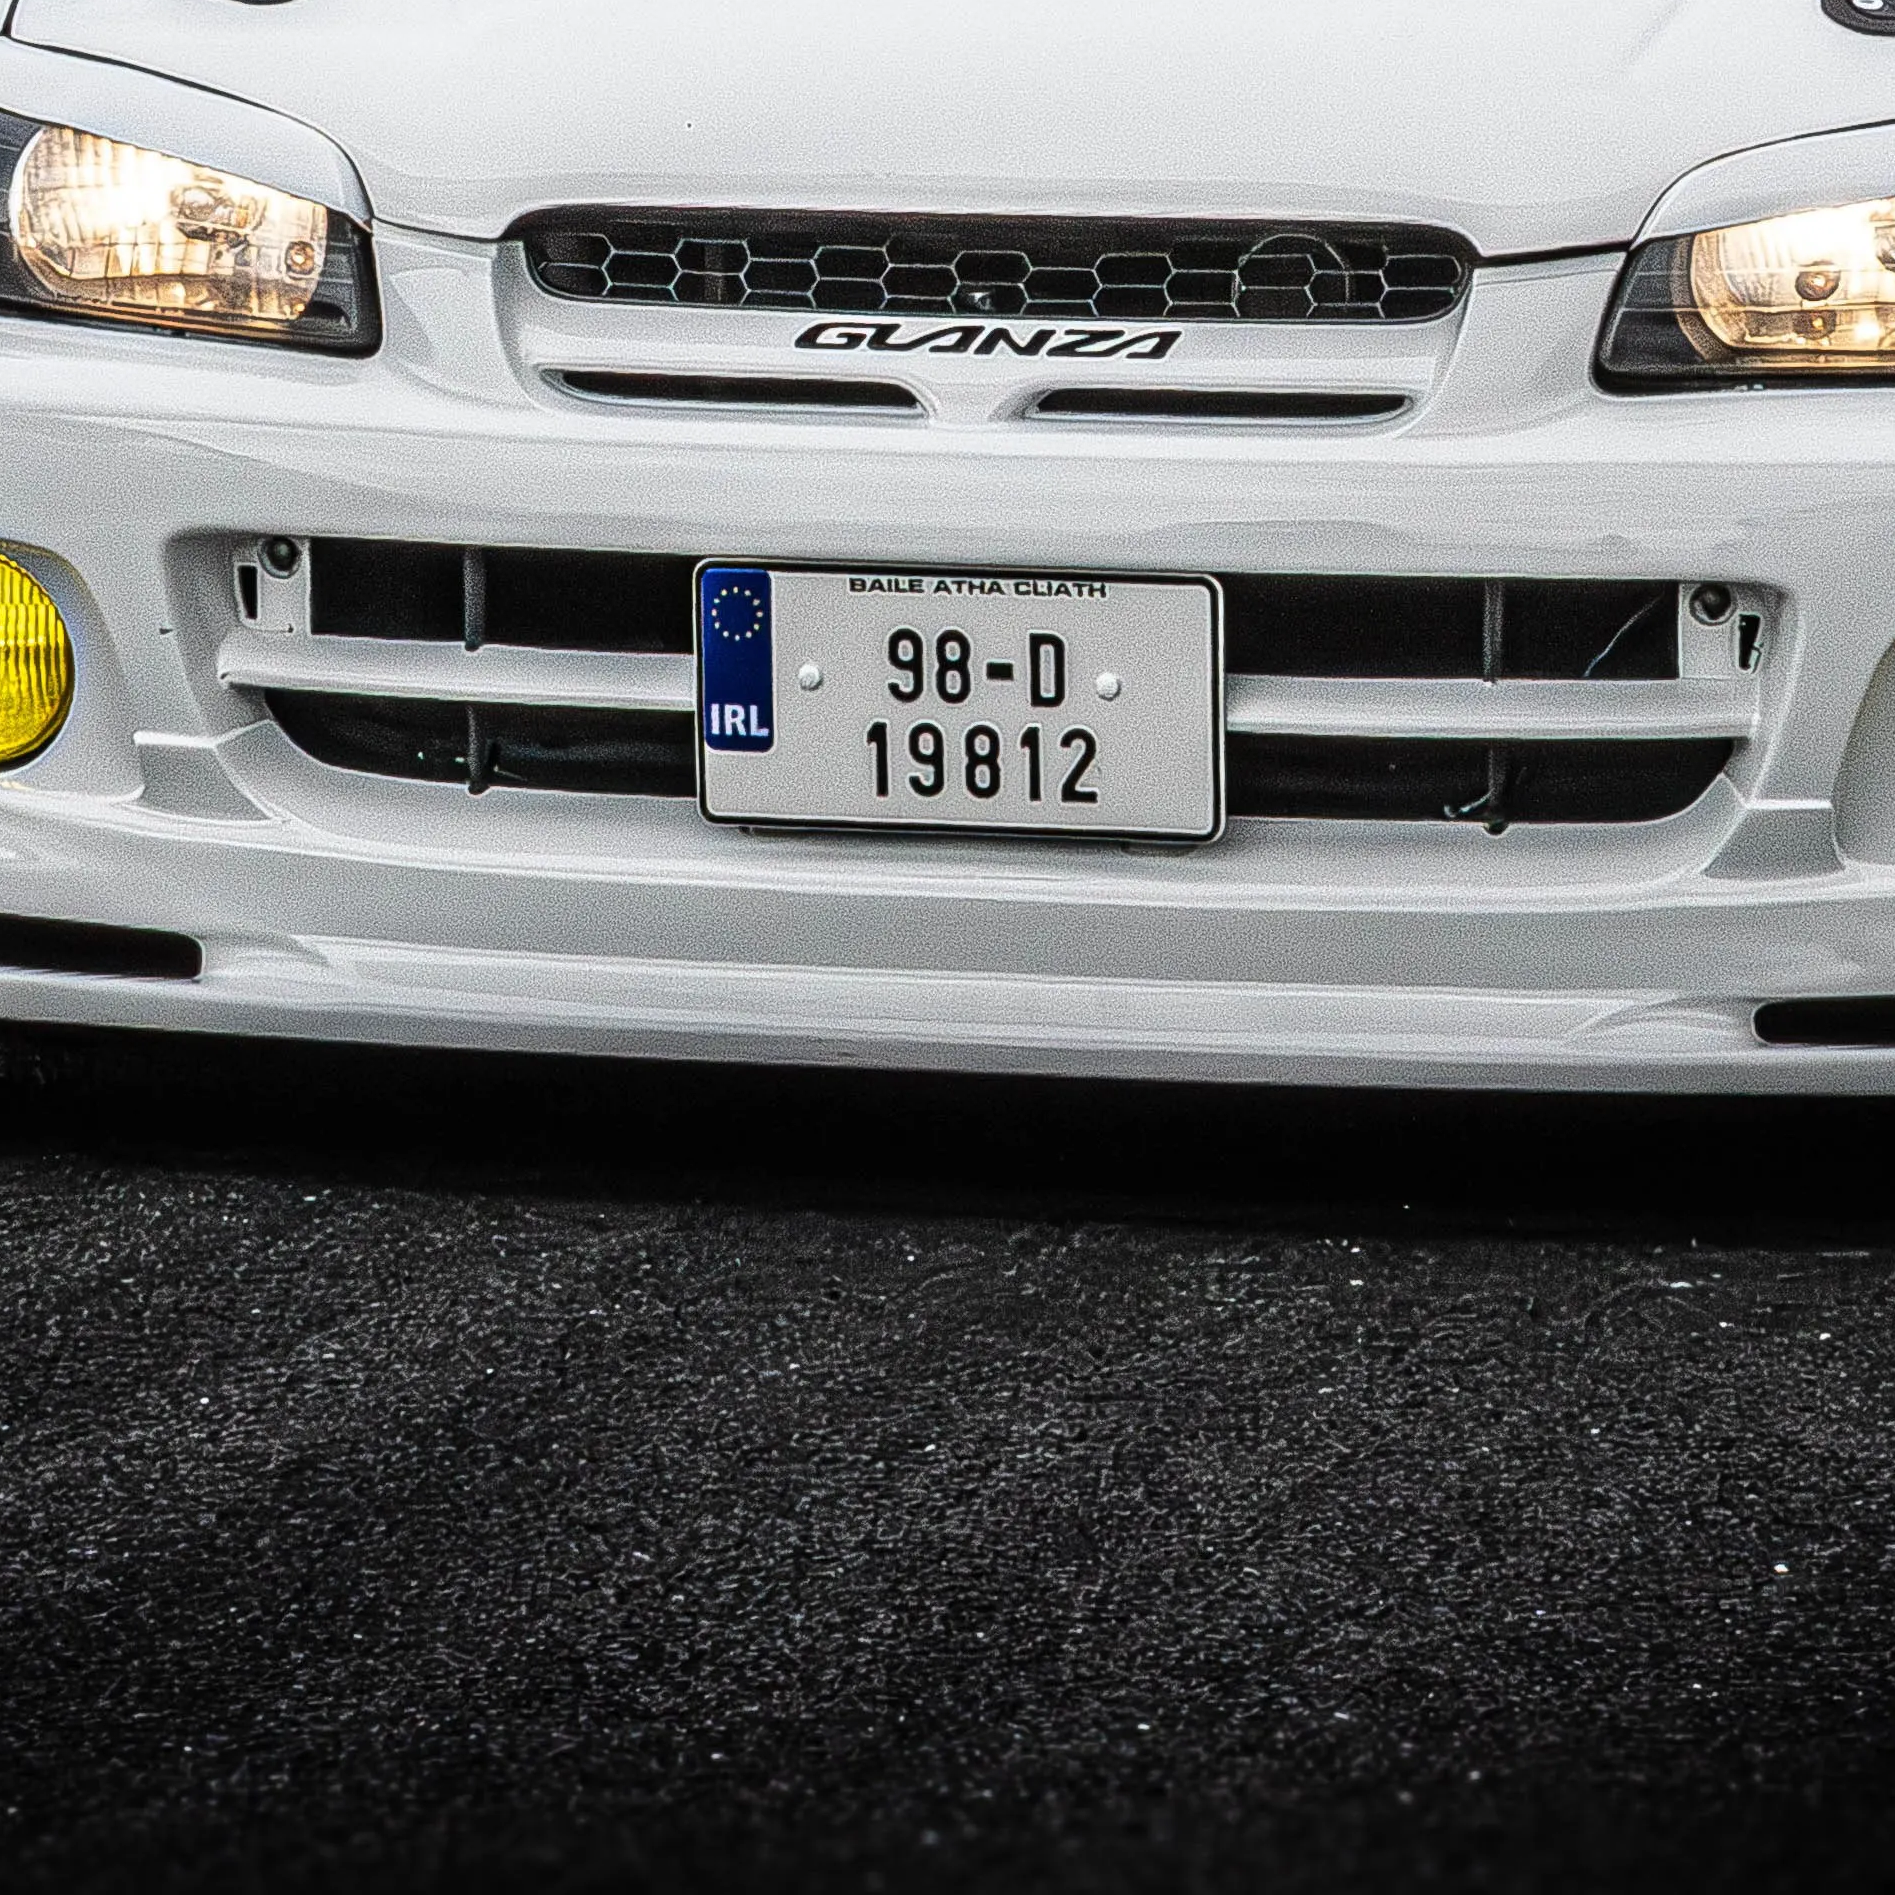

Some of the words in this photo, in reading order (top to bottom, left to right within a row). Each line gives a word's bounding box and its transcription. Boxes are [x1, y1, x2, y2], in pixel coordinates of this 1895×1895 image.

[793, 321, 1183, 360] GLANZA
[848, 577, 925, 594] BAILE
[1014, 580, 1107, 599] CLIATH
[887, 627, 1067, 709] 98-D
[710, 703, 770, 738] IRL
[866, 720, 1099, 804] 19812
